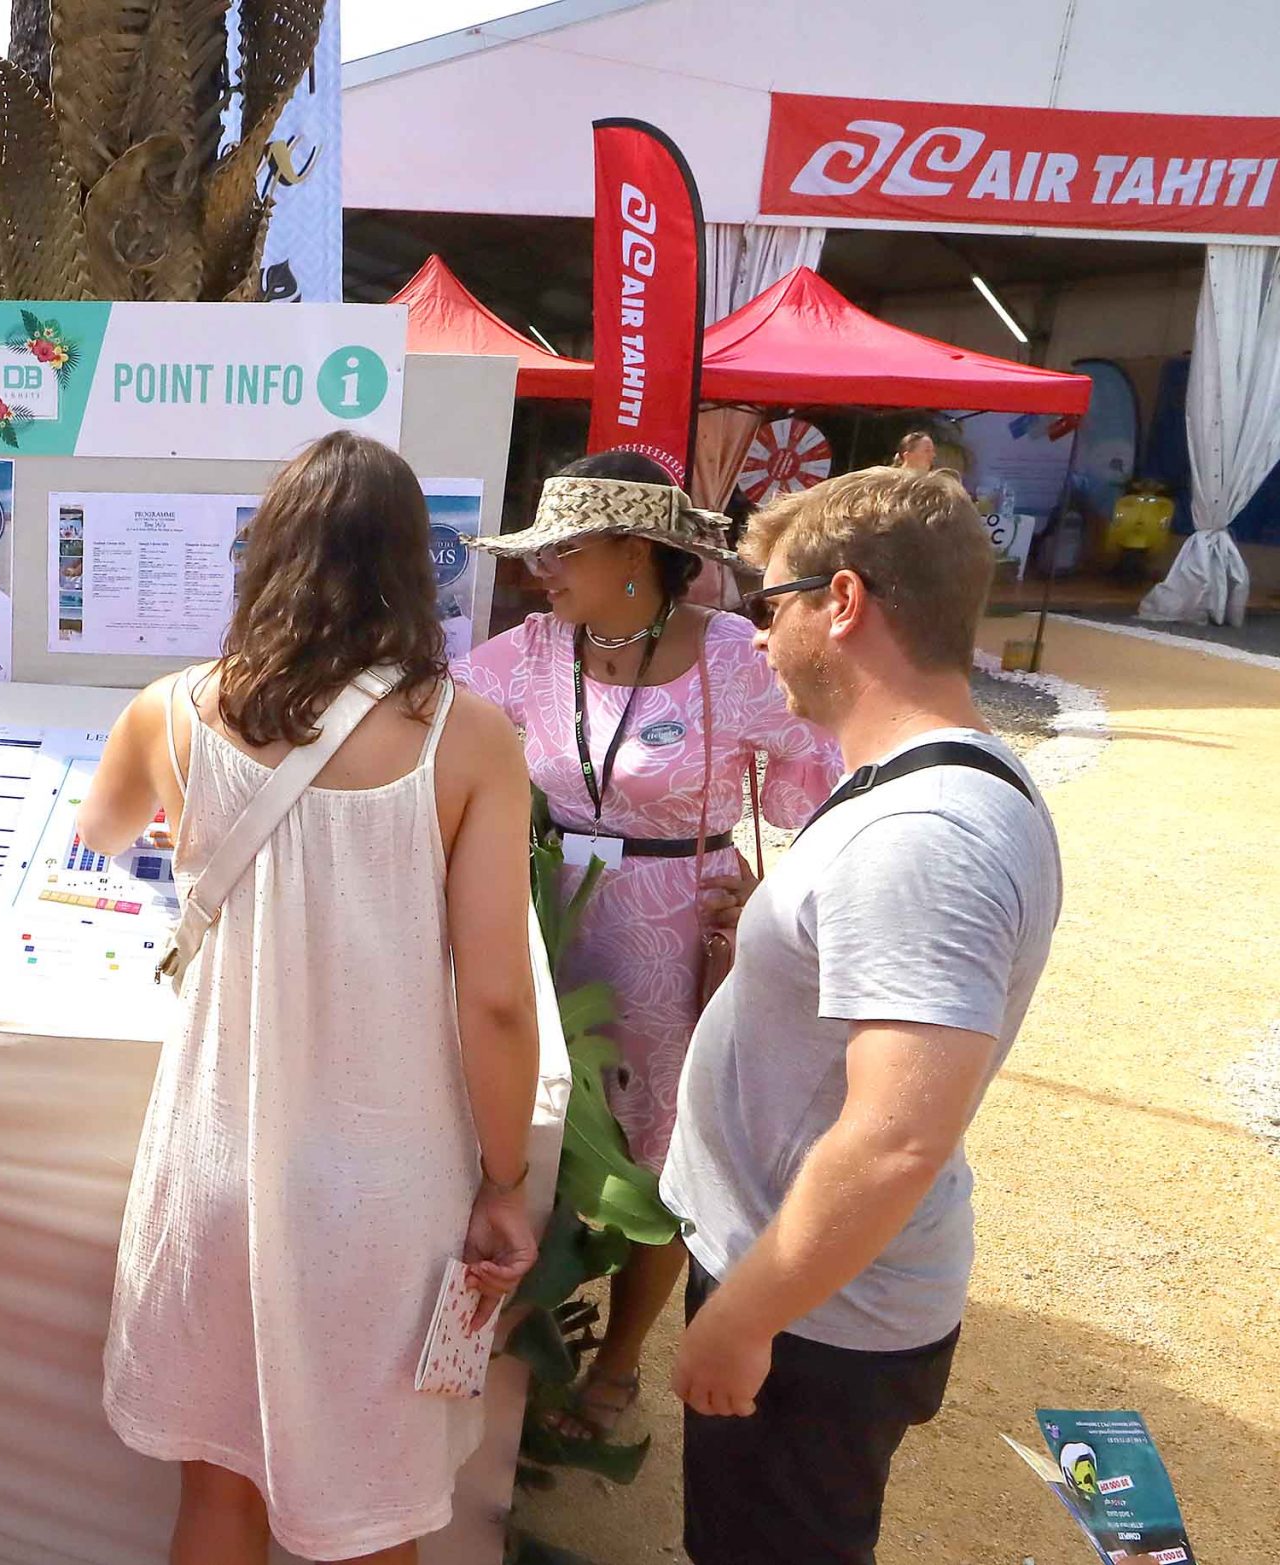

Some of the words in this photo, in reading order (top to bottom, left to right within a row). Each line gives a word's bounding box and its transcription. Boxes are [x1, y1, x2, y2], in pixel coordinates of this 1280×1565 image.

[968, 150, 1080, 204] AIR
[1091, 155, 1279, 208] TAHITI
[621, 274, 646, 328] AIR
[3, 365, 43, 389] DB
[113, 362, 214, 404] POINT
[225, 364, 303, 405] INFO
[617, 334, 646, 427] TAHITI
[428, 549, 456, 565] MS
